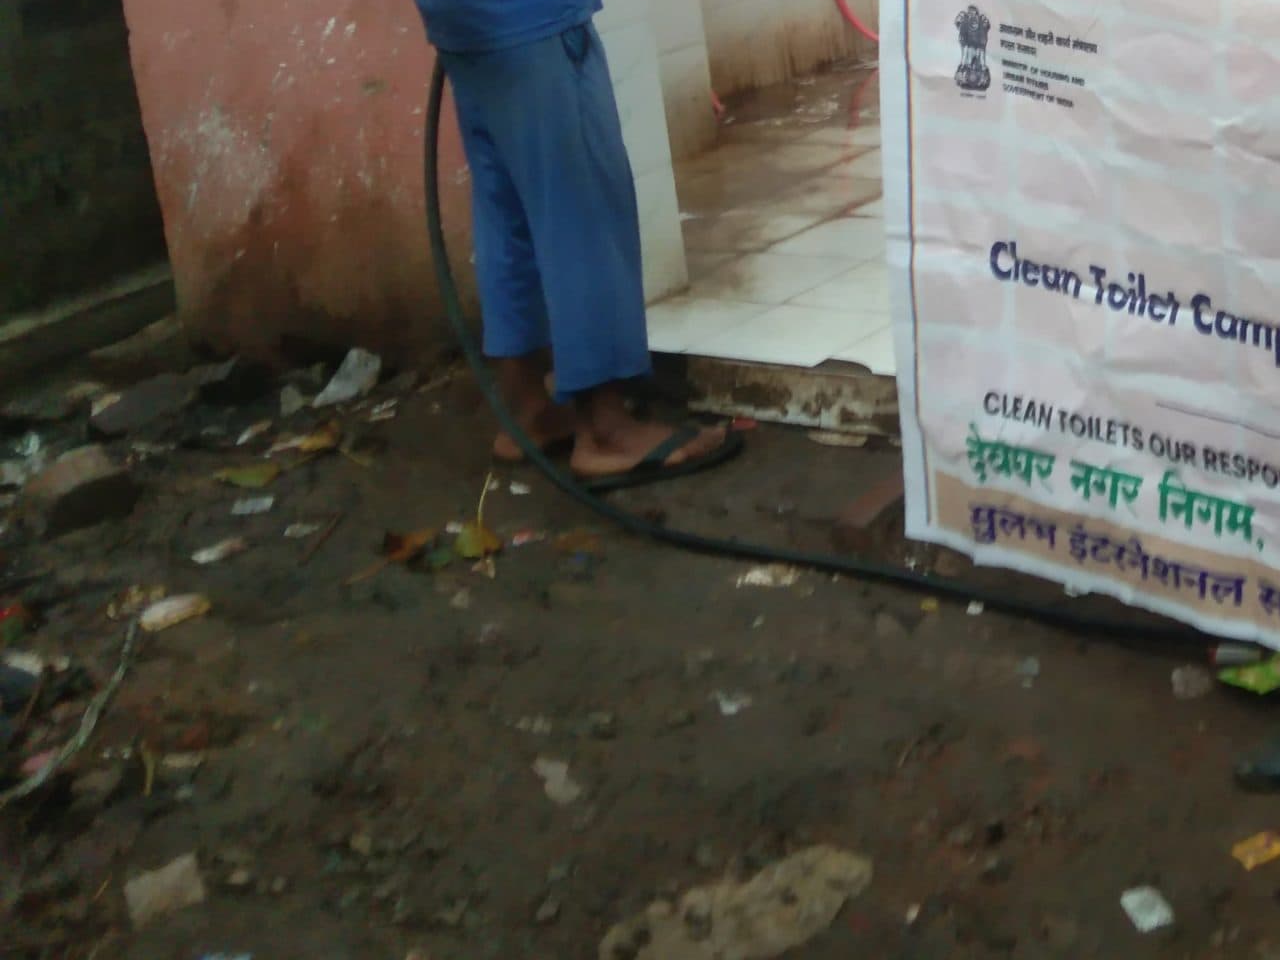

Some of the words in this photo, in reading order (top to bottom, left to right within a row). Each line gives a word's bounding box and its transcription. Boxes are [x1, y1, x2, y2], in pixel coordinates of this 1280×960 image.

[989, 241, 1081, 300] Clean
[1089, 265, 1180, 326] Toilet
[966, 422, 1056, 490] देवघर
[1069, 459, 1144, 514] नगर
[983, 391, 1053, 431] CLEAN
[1057, 409, 1145, 452] TOILETS
[1149, 431, 1197, 465] OUR
